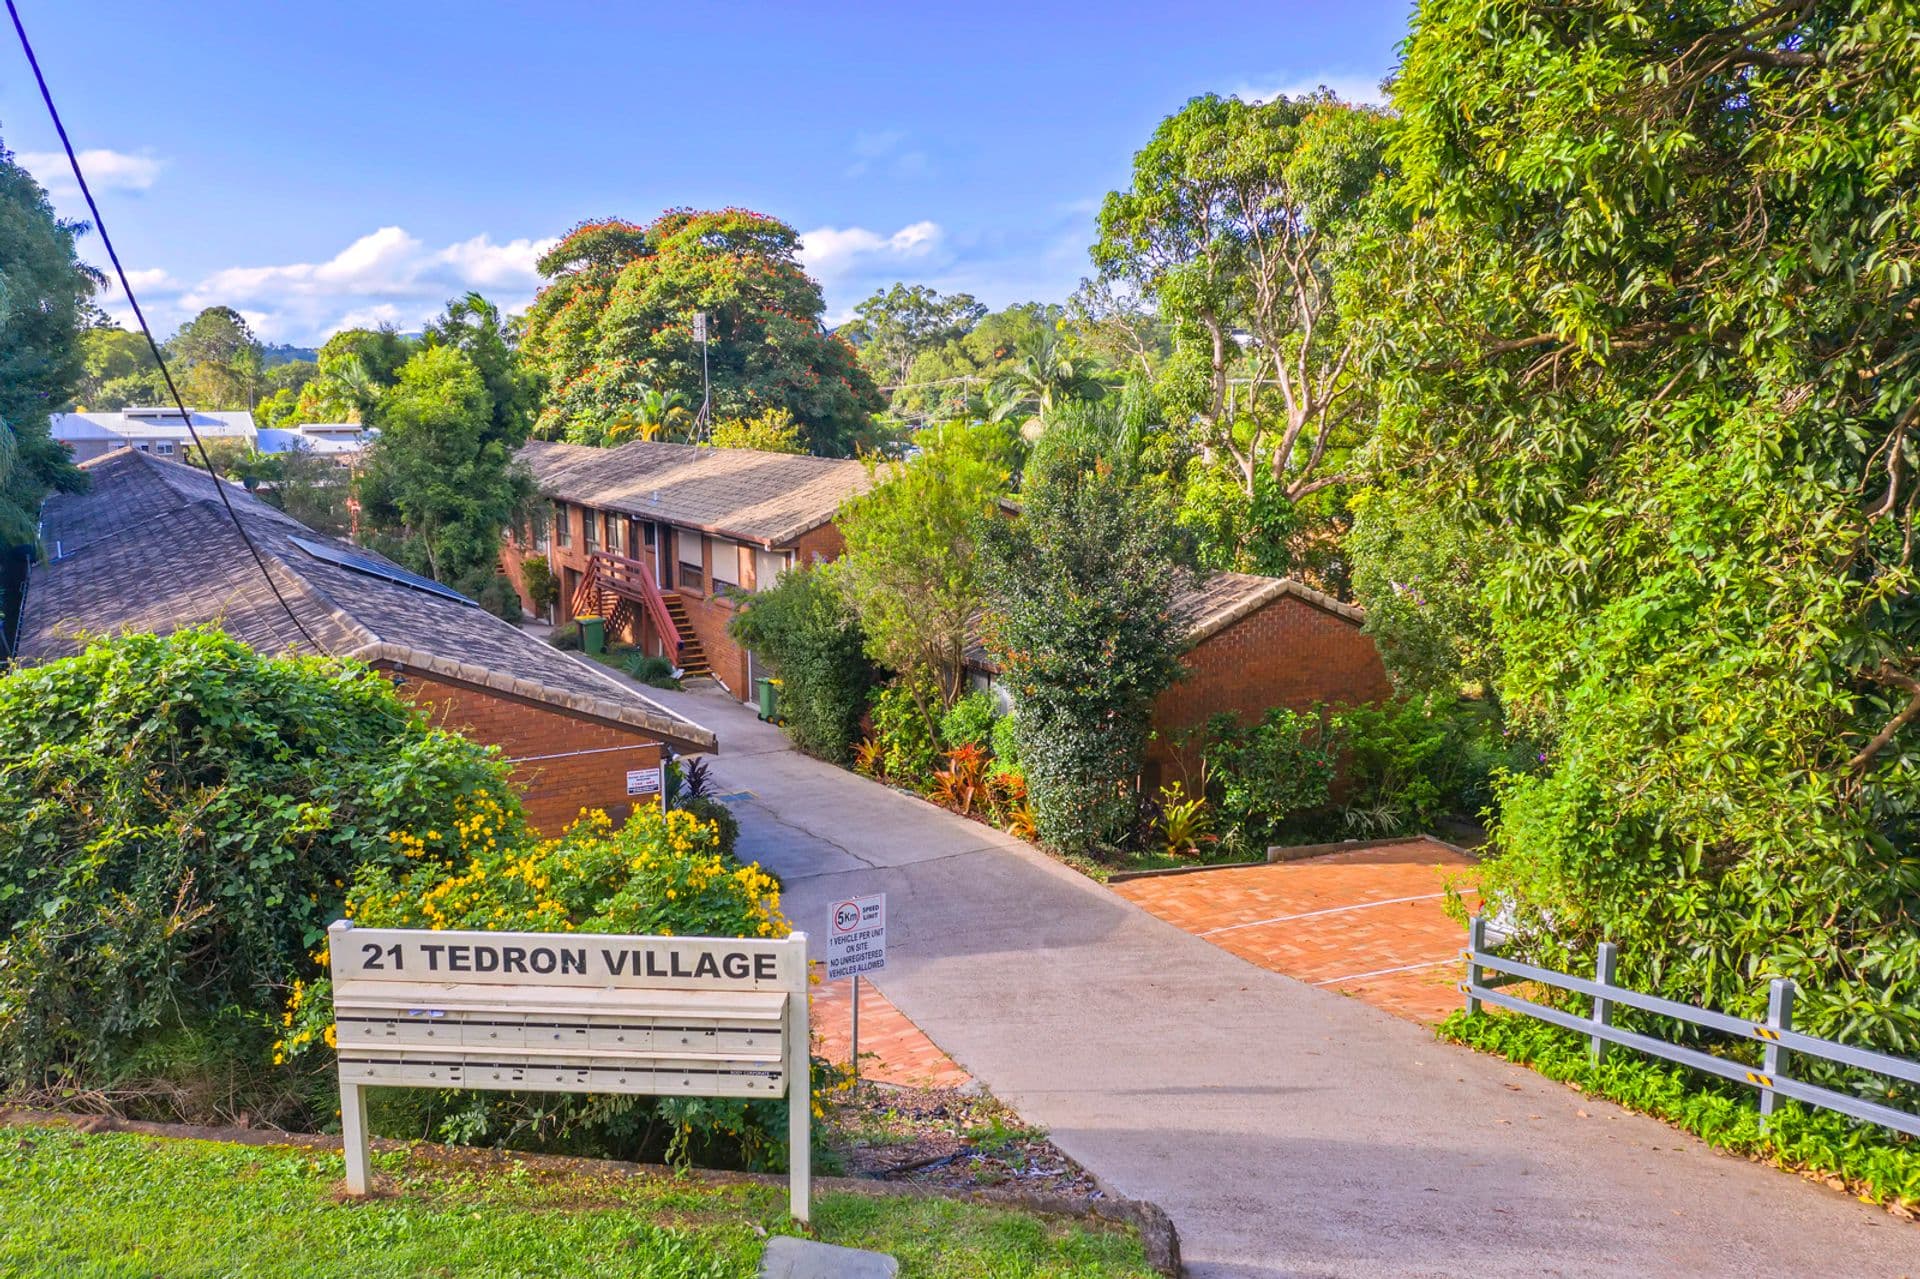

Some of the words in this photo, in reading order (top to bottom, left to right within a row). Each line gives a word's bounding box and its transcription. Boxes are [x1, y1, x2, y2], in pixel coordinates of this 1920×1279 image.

[862, 905, 879, 913] SPEED
[863, 912, 878, 920] LIMIT
[834, 933, 858, 945] VEHICLE
[859, 931, 870, 940] PER
[871, 928, 884, 937] UNIT
[846, 945, 855, 953] ON
[856, 942, 868, 952] SITE
[362, 943, 404, 970] 21
[420, 945, 587, 974] TEDRON
[601, 949, 777, 980] VILLAGE
[830, 958, 839, 967] NO
[840, 949, 883, 965] UNREGISTERED
[829, 965, 856, 978] VEHICLES
[857, 959, 884, 971] ALLOWED
